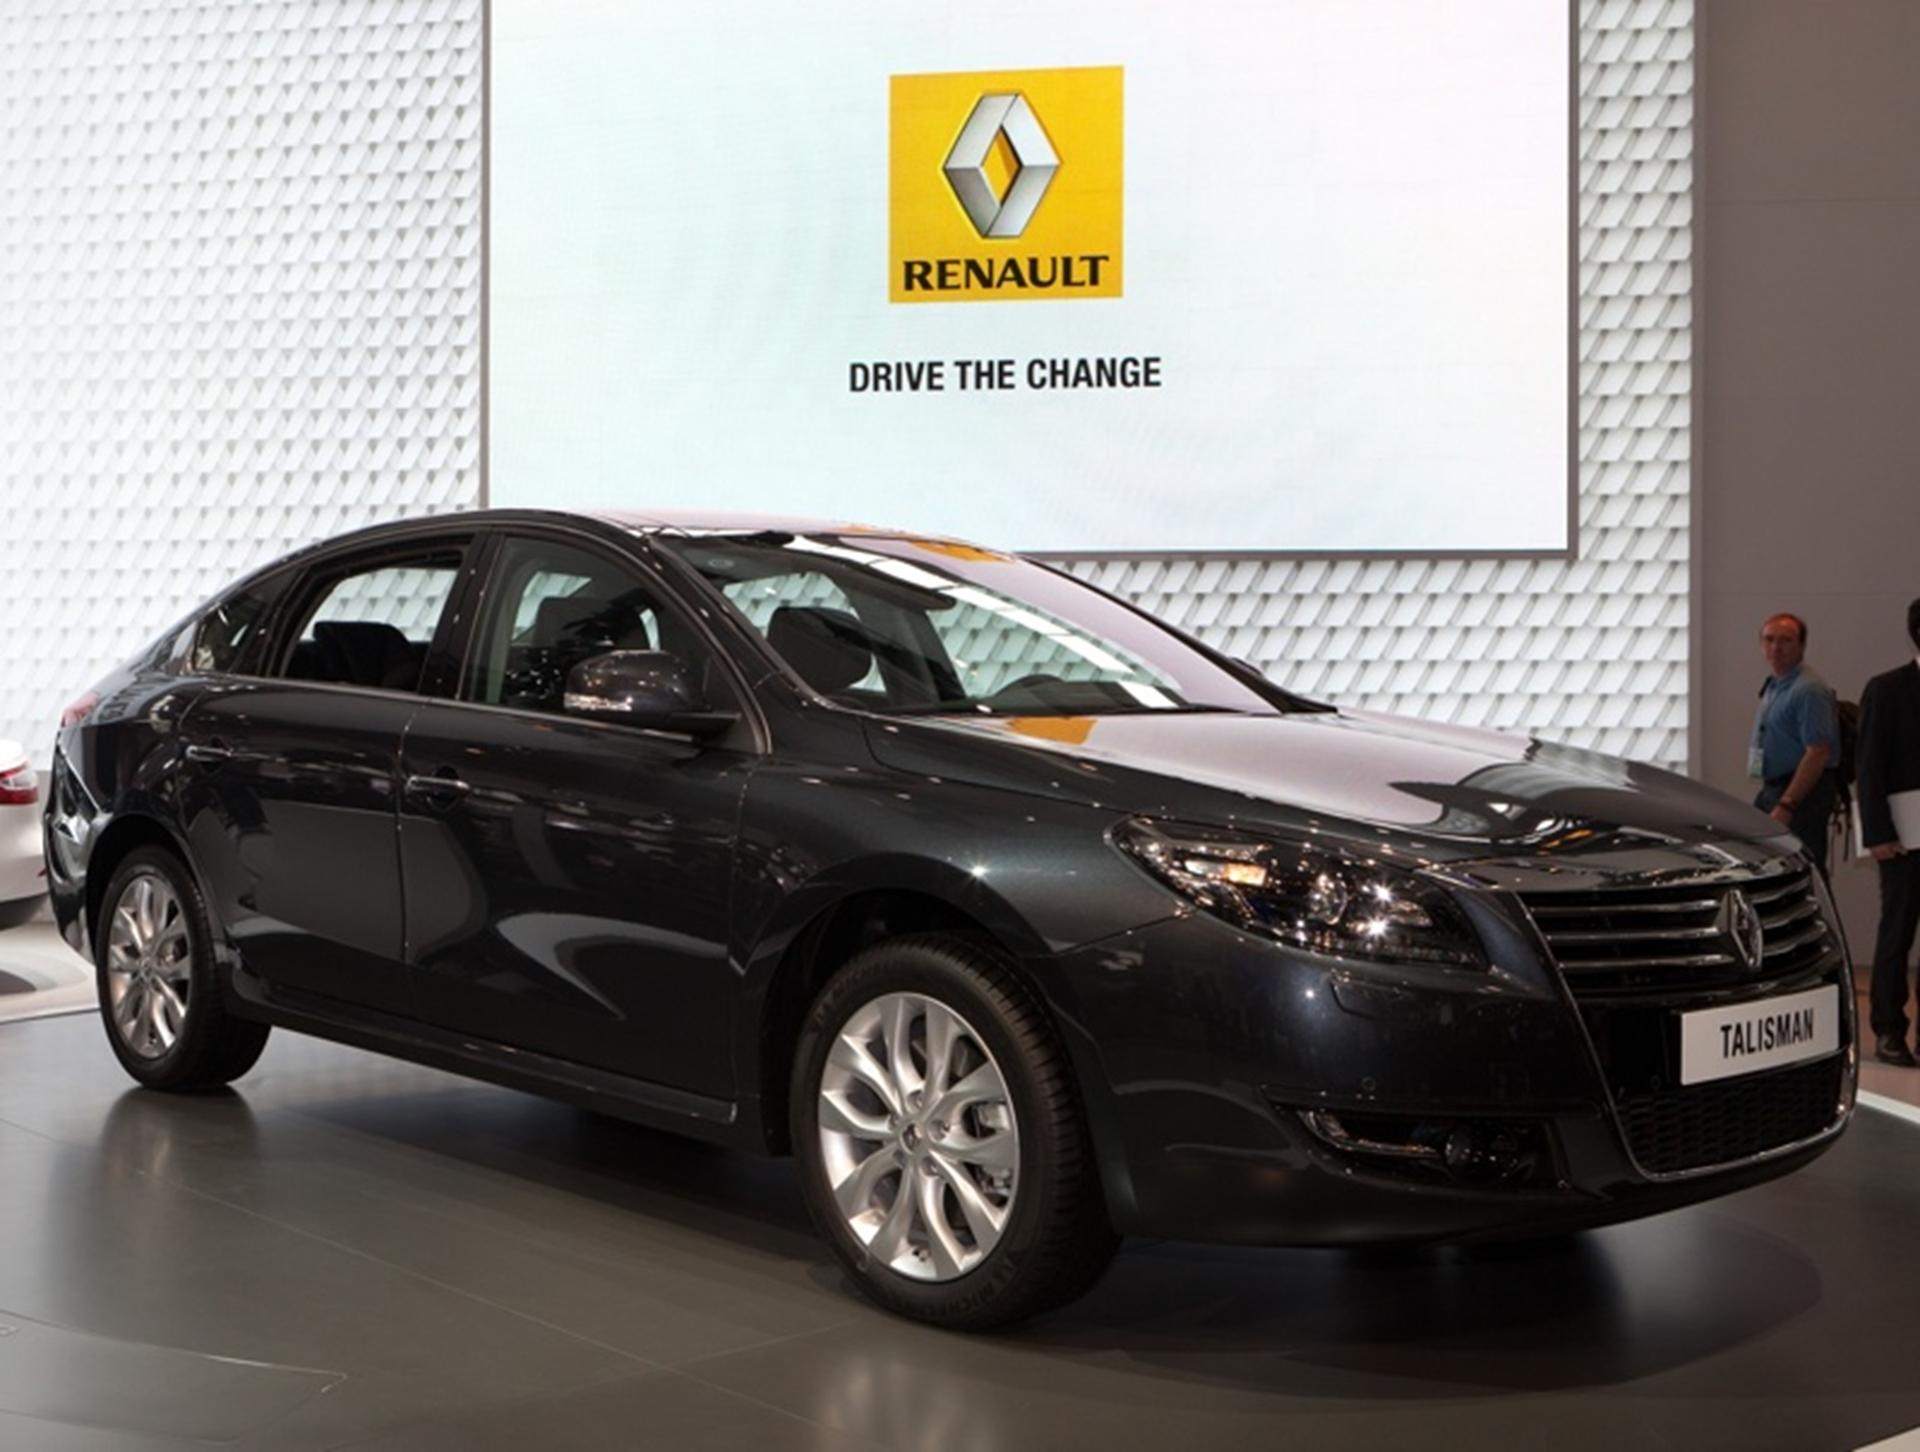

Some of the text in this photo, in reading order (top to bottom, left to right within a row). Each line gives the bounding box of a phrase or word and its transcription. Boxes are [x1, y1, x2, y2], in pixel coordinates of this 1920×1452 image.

[903, 255, 1109, 291] RENAULT
[849, 357, 1162, 392] DRIVE THE CHANGE
[1720, 1008, 1814, 1059] TALISMAN
